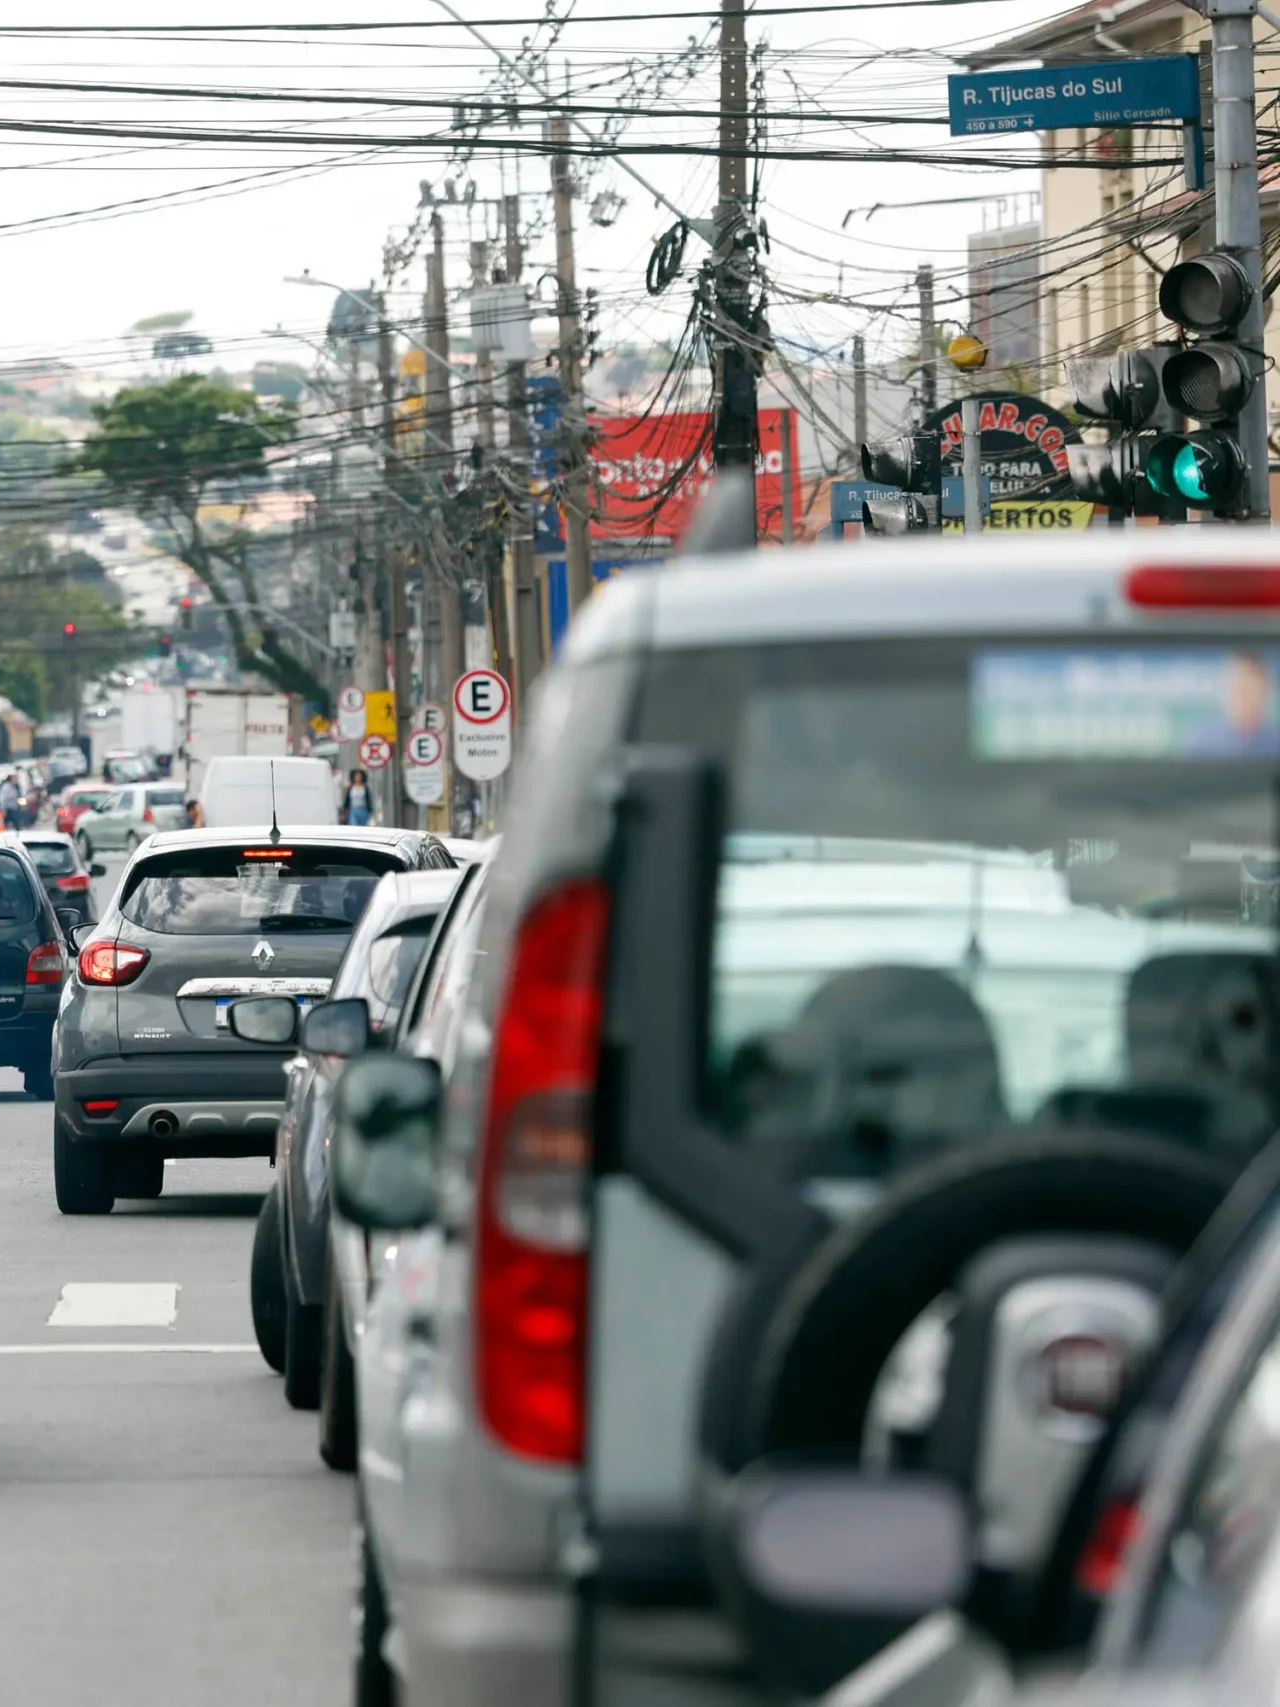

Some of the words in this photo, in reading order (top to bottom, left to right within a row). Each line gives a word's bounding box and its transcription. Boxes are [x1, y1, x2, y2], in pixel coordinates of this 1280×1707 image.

[963, 89, 982, 105] R.
[988, 85, 1056, 106] Tijucas
[1062, 80, 1086, 97] do
[1091, 77, 1122, 95] Sul
[1123, 106, 1172, 119] Cercado
[966, 122, 986, 131] 450
[988, 122, 995, 130] a
[998, 120, 1018, 129] 590
[1000, 462, 1042, 477] PARA
[848, 490, 861, 501] R.
[472, 681, 490, 711] E
[460, 733, 506, 742] Exclusivo
[418, 738, 430, 758] E
[468, 748, 498, 757] Motos
